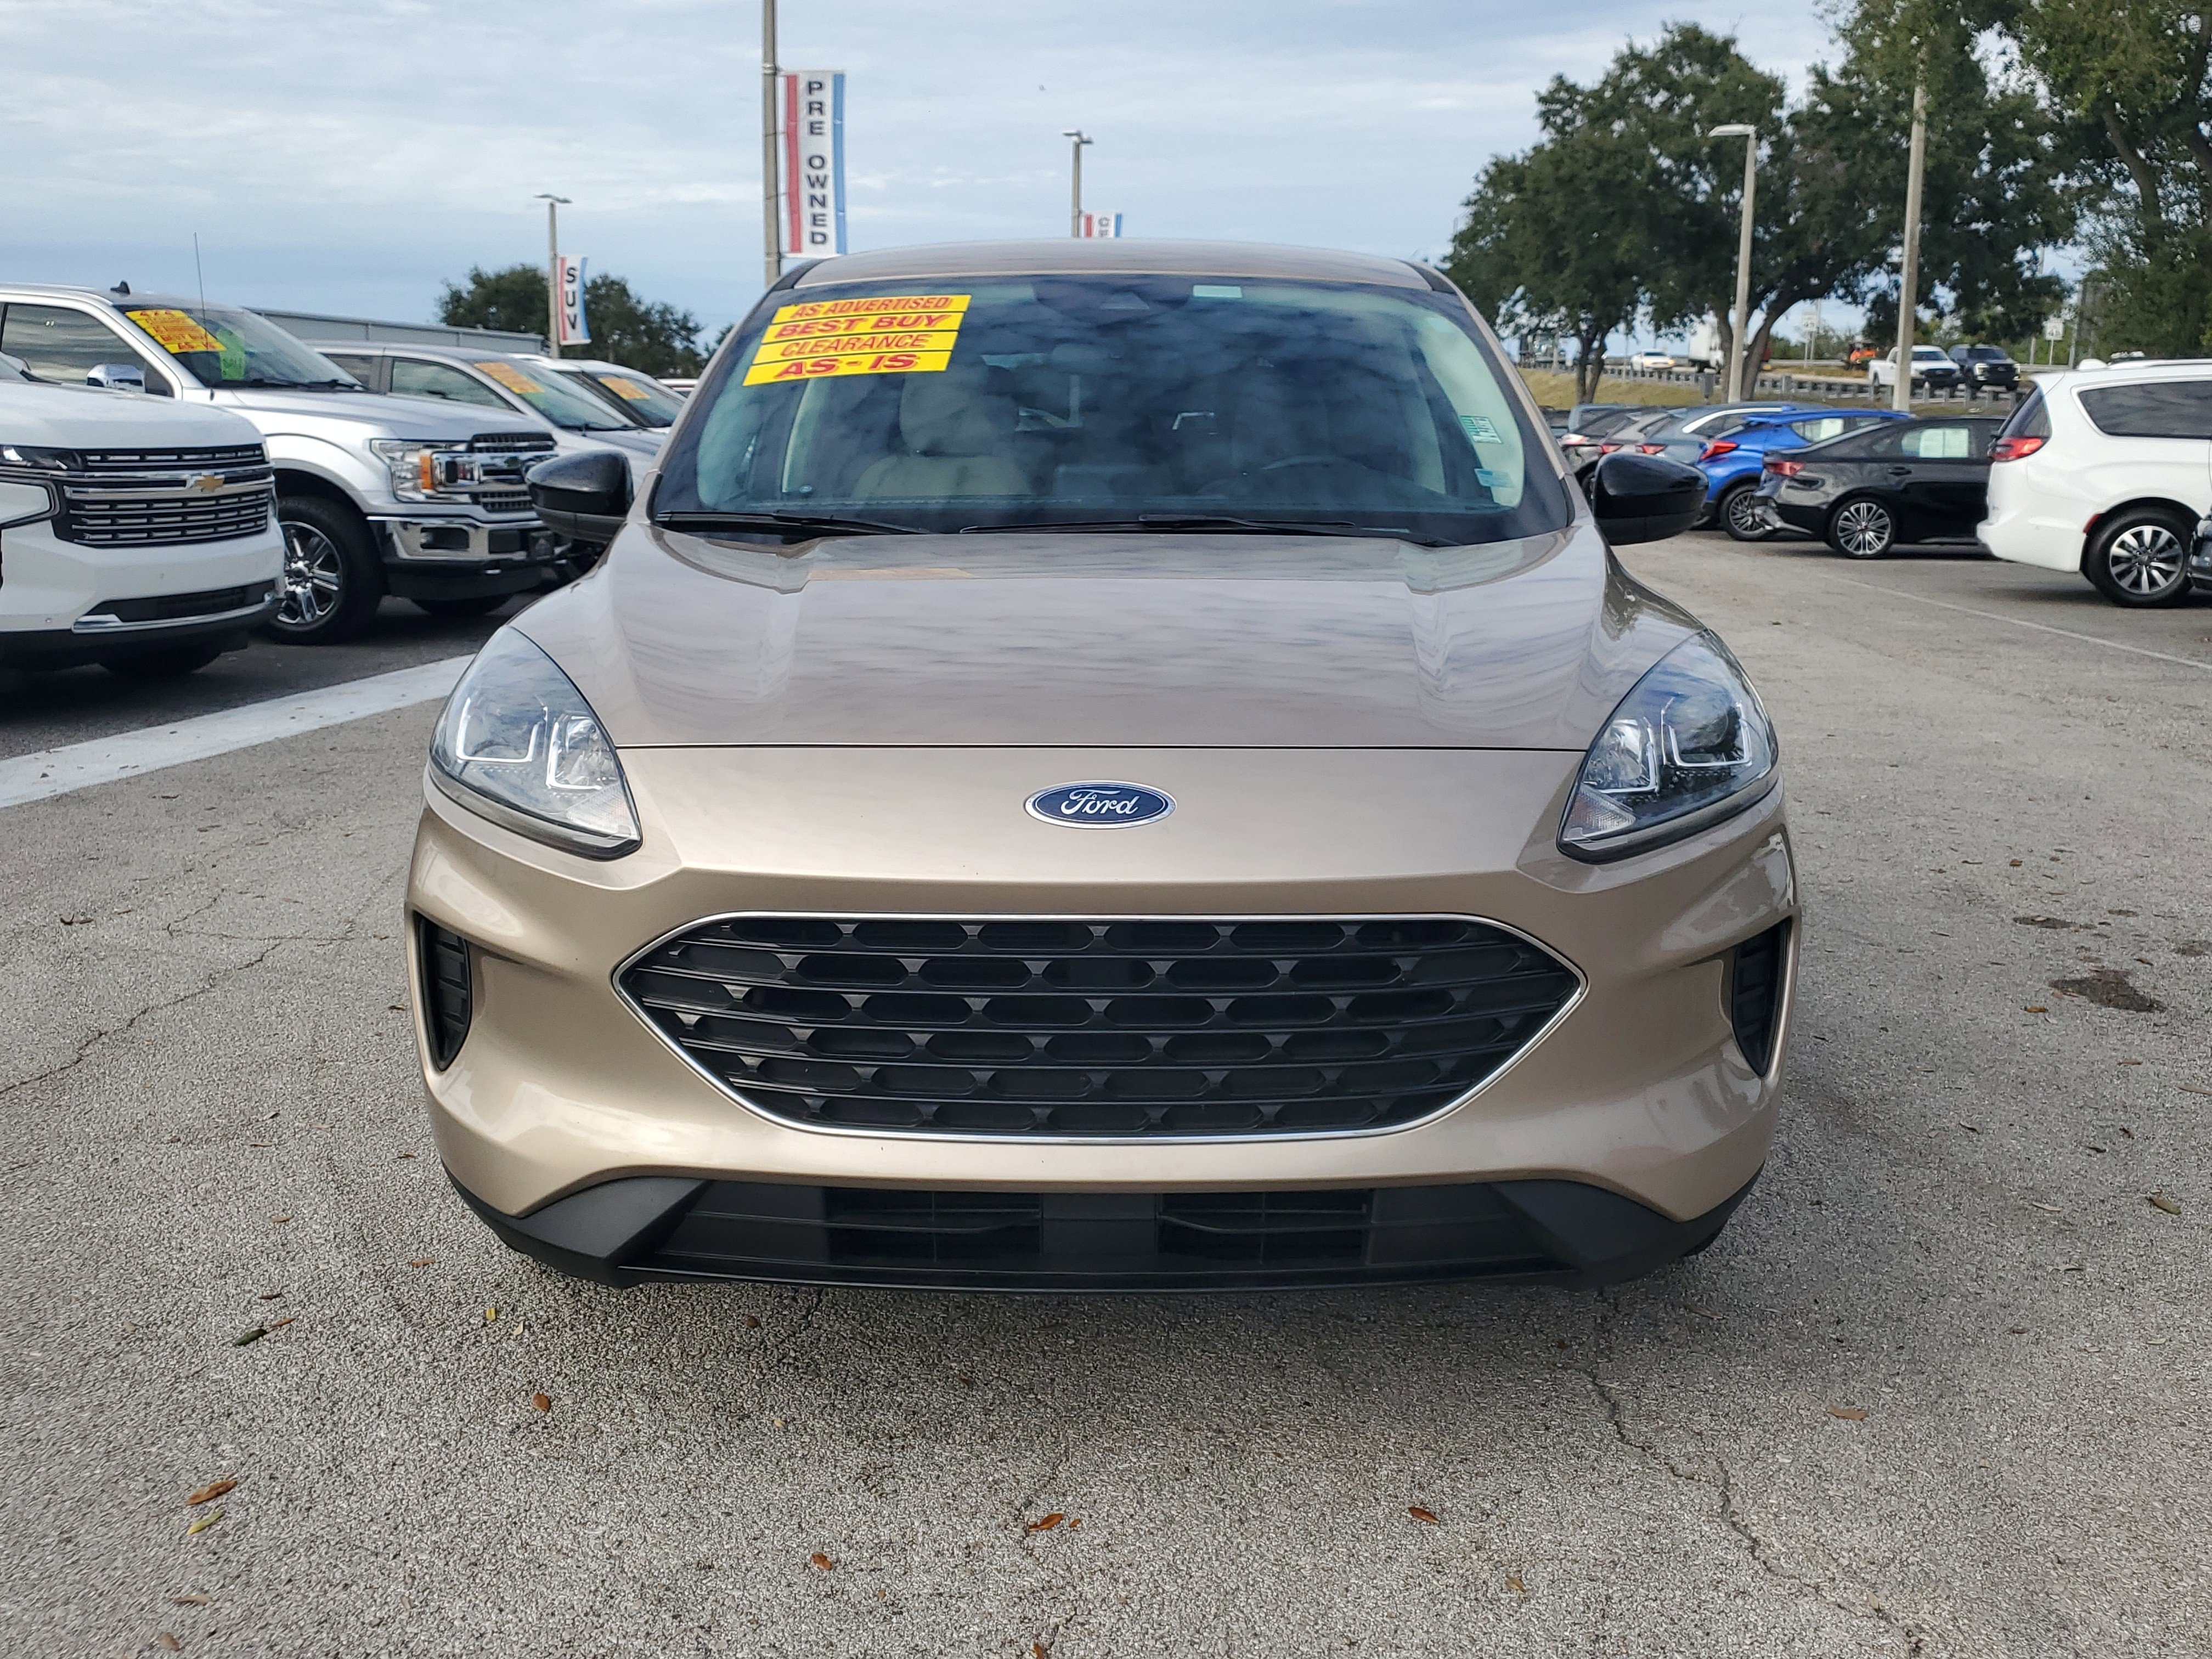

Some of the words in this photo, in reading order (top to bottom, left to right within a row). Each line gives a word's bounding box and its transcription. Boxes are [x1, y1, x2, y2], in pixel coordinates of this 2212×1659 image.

[808, 80, 825, 136] PRE
[806, 154, 828, 245] OWNED
[566, 267, 577, 330] SUV
[791, 303, 822, 319] AS
[825, 297, 953, 314] ADVERTISED
[774, 317, 867, 339] BEST
[870, 314, 952, 330] BUY
[780, 333, 933, 357] CLEARANCE
[1060, 789, 1140, 815] Ford
